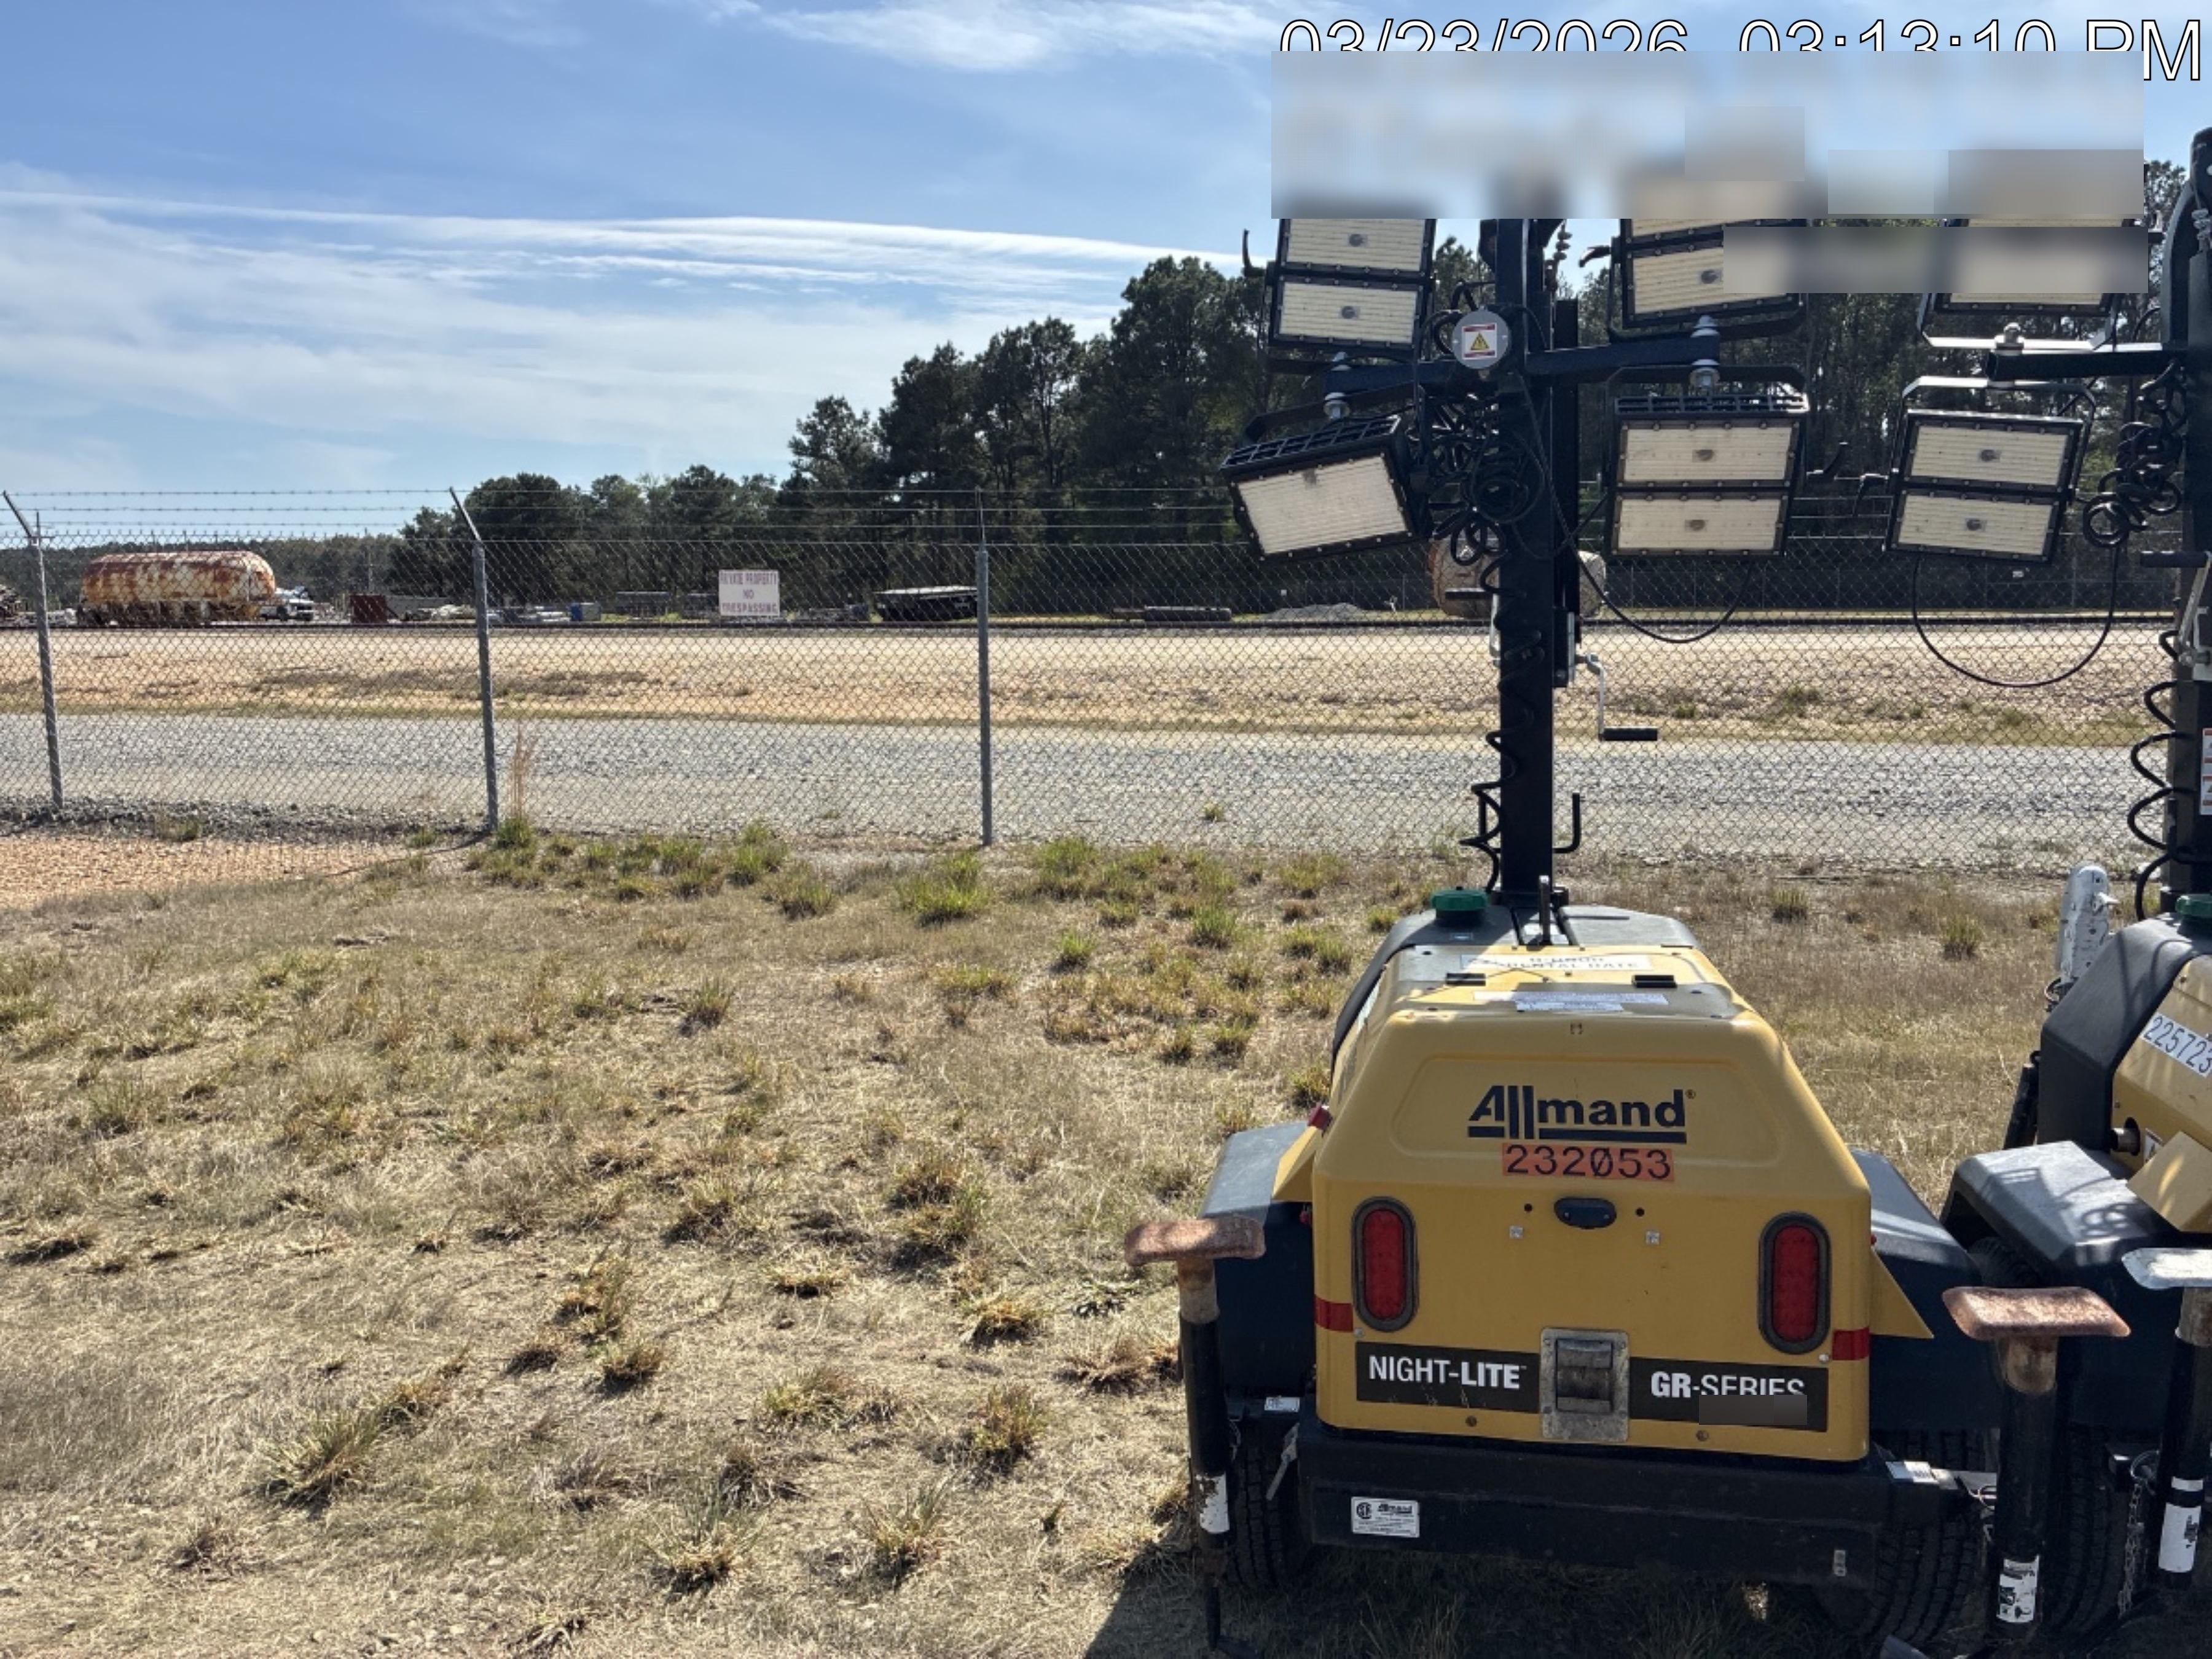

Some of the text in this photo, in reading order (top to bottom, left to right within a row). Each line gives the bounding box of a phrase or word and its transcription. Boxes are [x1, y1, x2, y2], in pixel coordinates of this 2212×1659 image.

[742, 589, 755, 600] NO
[1468, 1085, 1685, 1139] Allmand
[1506, 1144, 1671, 1180] 232053
[1369, 1355, 1805, 1398] NIGHT-LITE GR-SERIES
